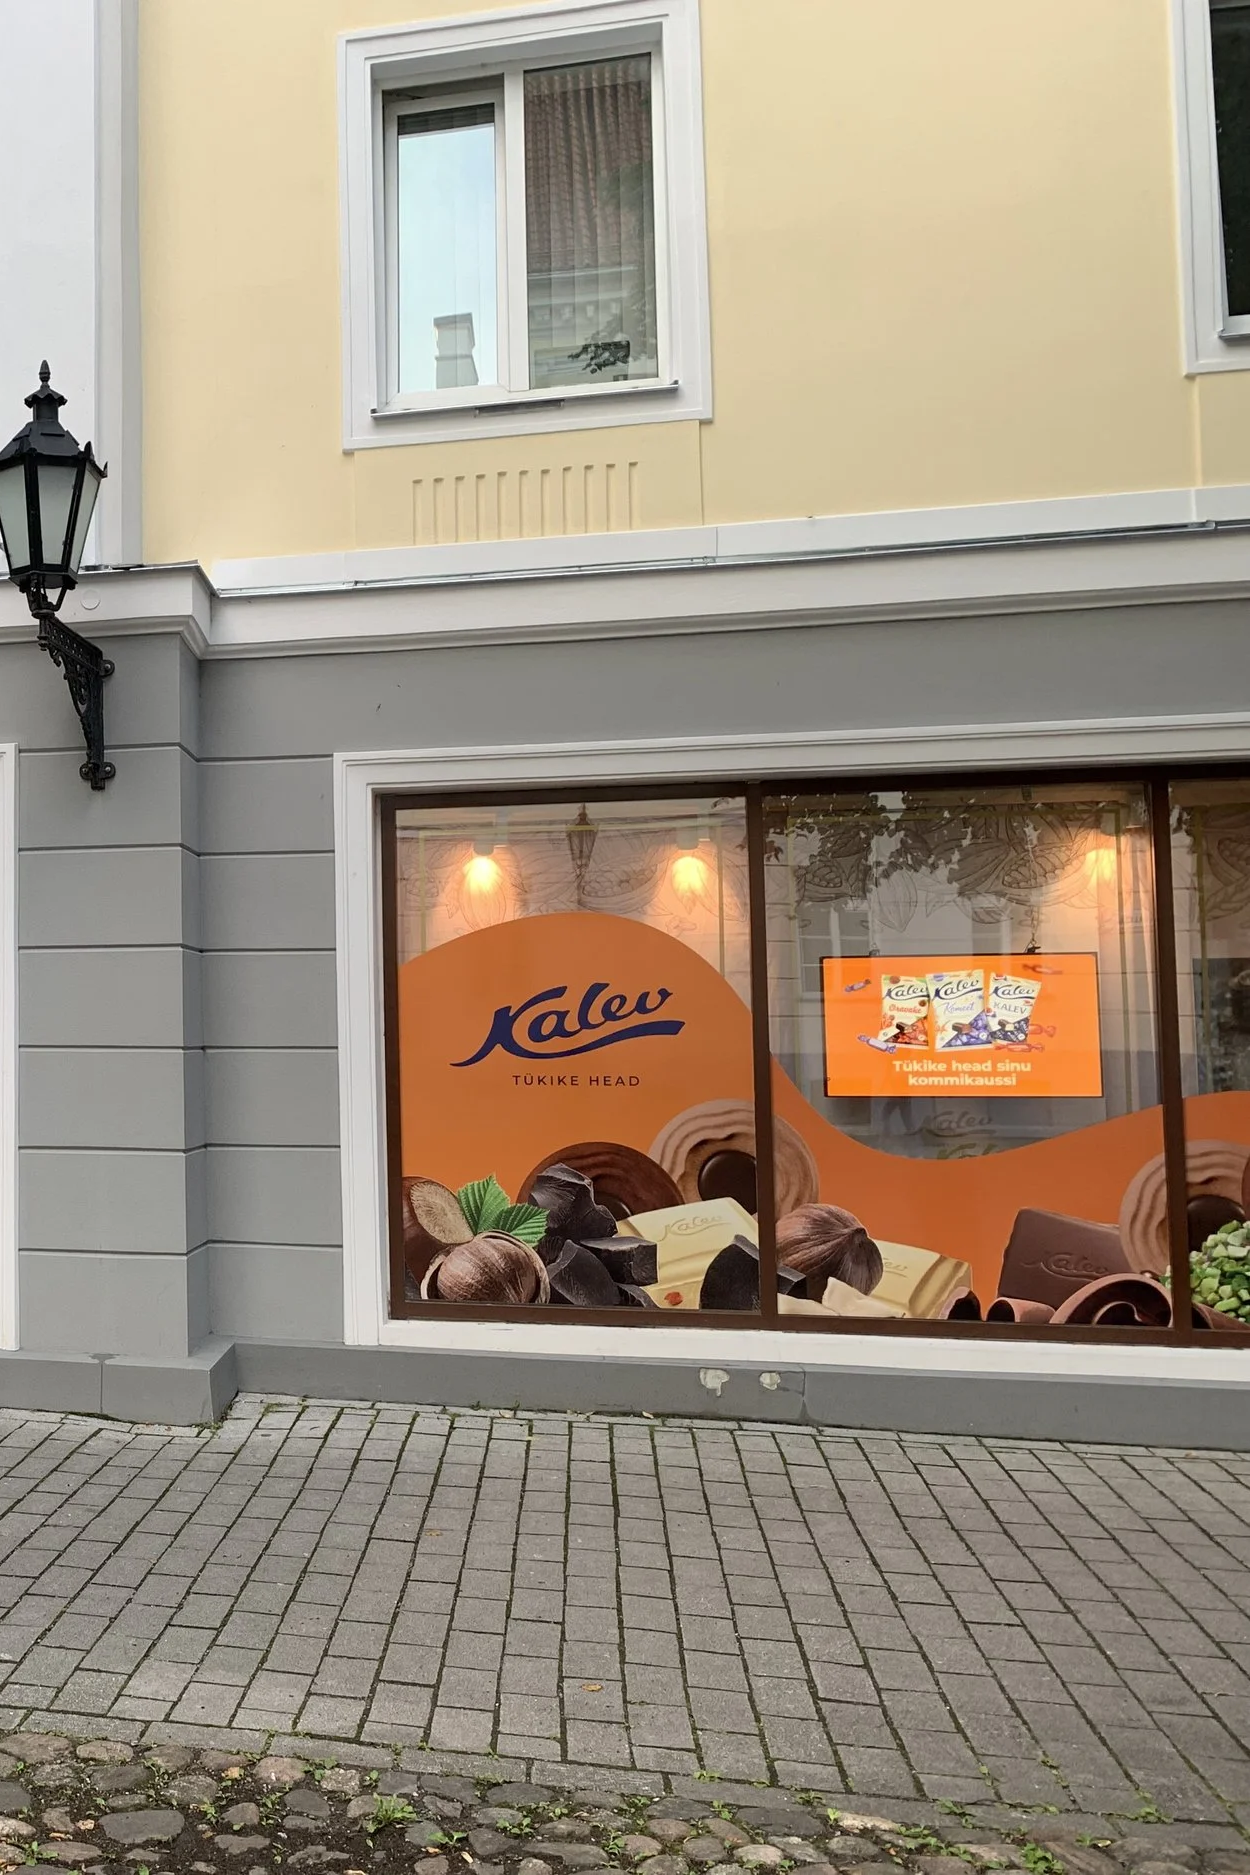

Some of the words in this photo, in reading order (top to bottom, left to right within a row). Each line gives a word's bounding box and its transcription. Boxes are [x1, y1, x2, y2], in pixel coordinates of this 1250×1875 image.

[931, 979, 983, 1002] Kalev
[988, 984, 1036, 1000] Kalev
[993, 1002, 1027, 1014] KALEV
[449, 982, 686, 1067] Kalev
[892, 1060, 947, 1073] Tükike
[951, 1060, 993, 1072] head
[996, 1060, 1032, 1072] sinu
[512, 1073, 580, 1087] TÜKIKE
[589, 1075, 641, 1087] HEAD
[907, 1074, 1017, 1087] kommikaussi
